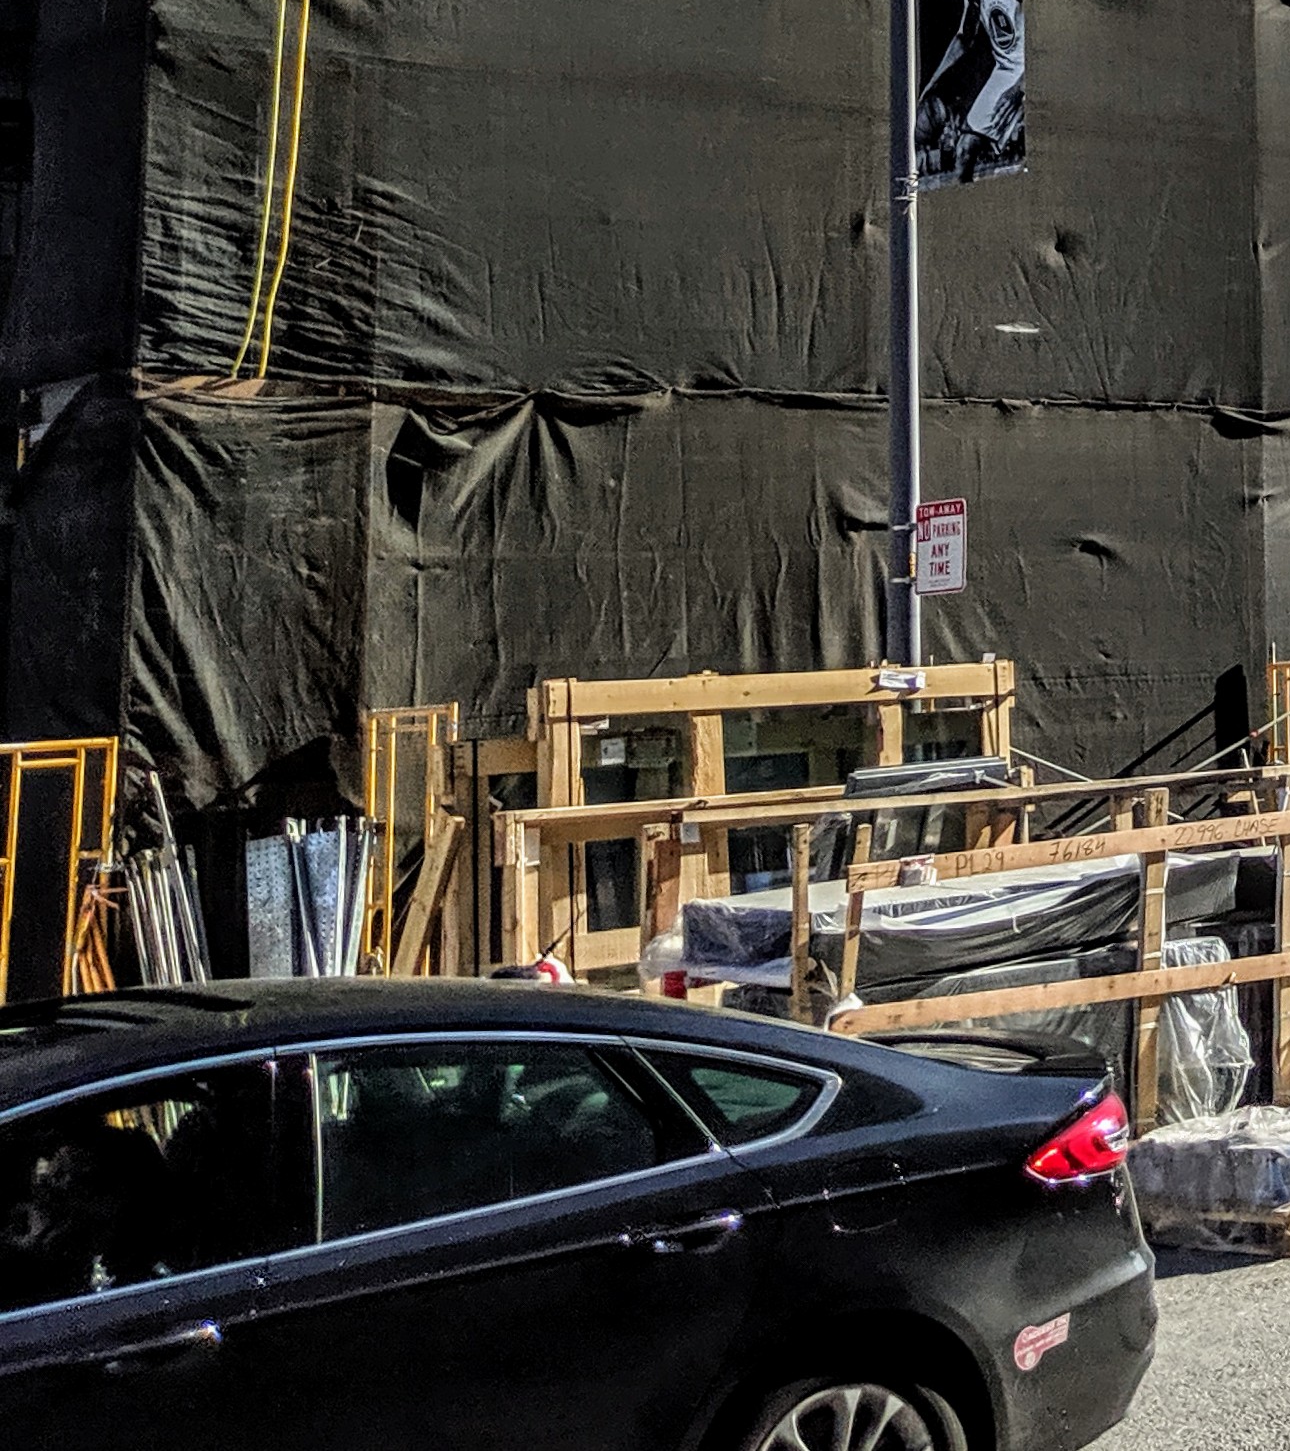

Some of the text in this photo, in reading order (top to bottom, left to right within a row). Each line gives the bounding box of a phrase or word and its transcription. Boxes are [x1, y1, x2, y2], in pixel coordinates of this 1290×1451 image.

[917, 519, 961, 541] NO PARKING
[931, 543, 950, 558] ANY
[929, 560, 951, 576] TIME
[1233, 816, 1280, 839] CHASE
